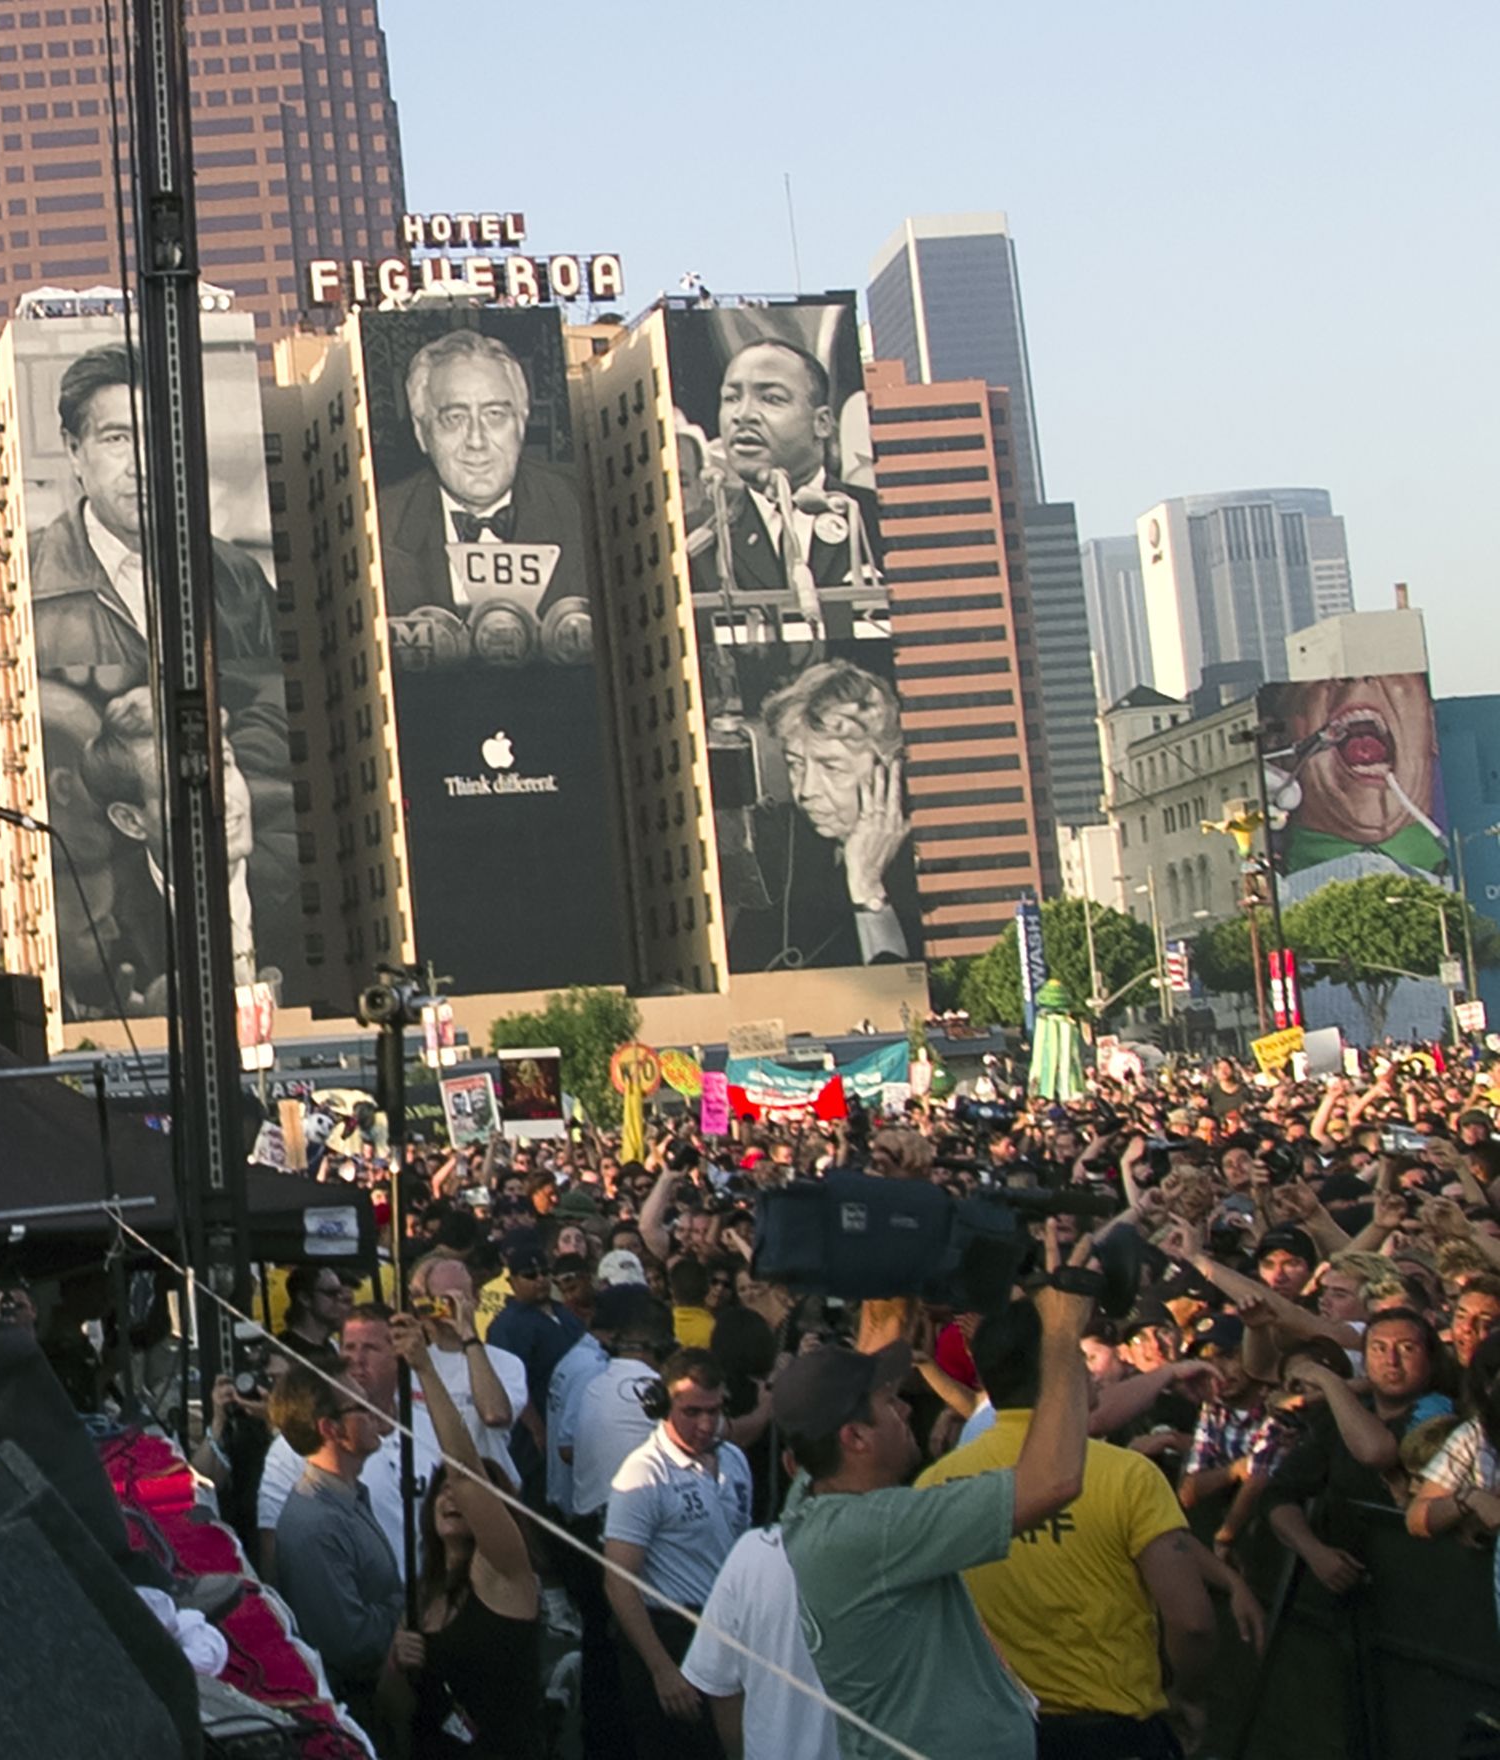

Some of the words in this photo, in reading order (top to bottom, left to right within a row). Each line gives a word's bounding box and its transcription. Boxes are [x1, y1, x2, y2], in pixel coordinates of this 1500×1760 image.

[403, 213, 525, 243] HOTEL
[311, 254, 623, 303] FIGUEROA
[466, 551, 540, 585] CBS
[444, 774, 492, 796] Think
[1025, 914, 1046, 990] WASH
[682, 1490, 704, 1512] 35
